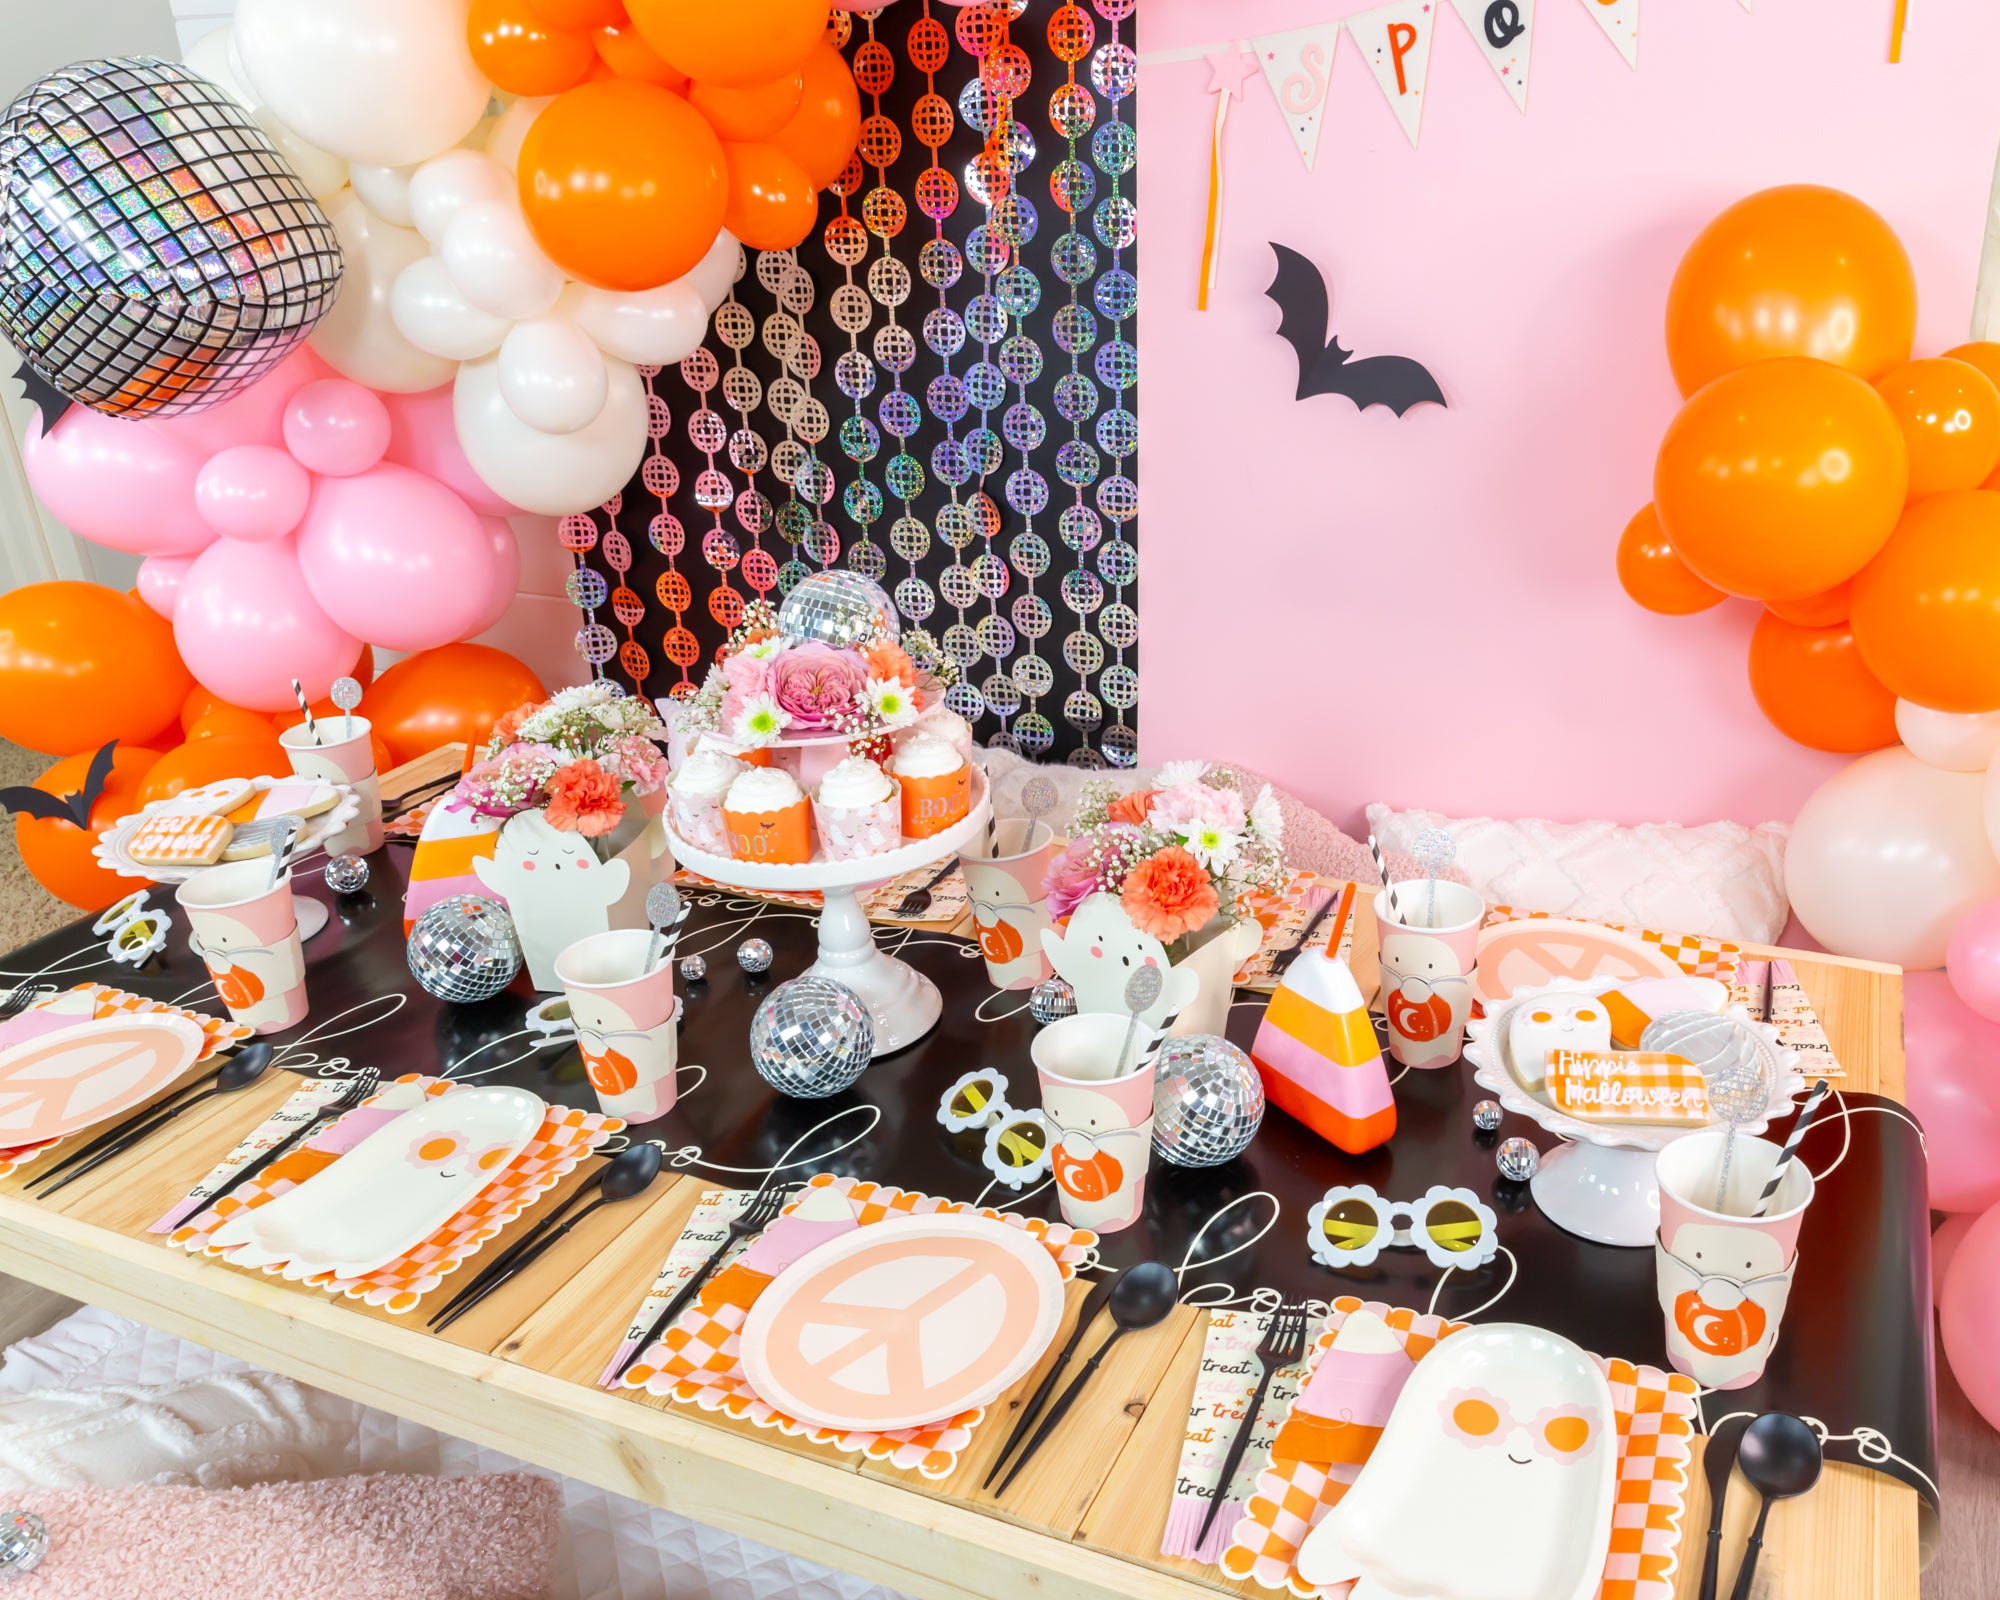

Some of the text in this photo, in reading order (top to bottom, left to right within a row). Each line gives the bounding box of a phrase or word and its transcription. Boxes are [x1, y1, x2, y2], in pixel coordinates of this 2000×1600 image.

[919, 793, 961, 819] BOO
[1558, 1050, 1640, 1081] Hippie
[1564, 1077, 1706, 1107] Halloween
[680, 1229, 727, 1242] treat
[1203, 1358, 1253, 1374] treat
